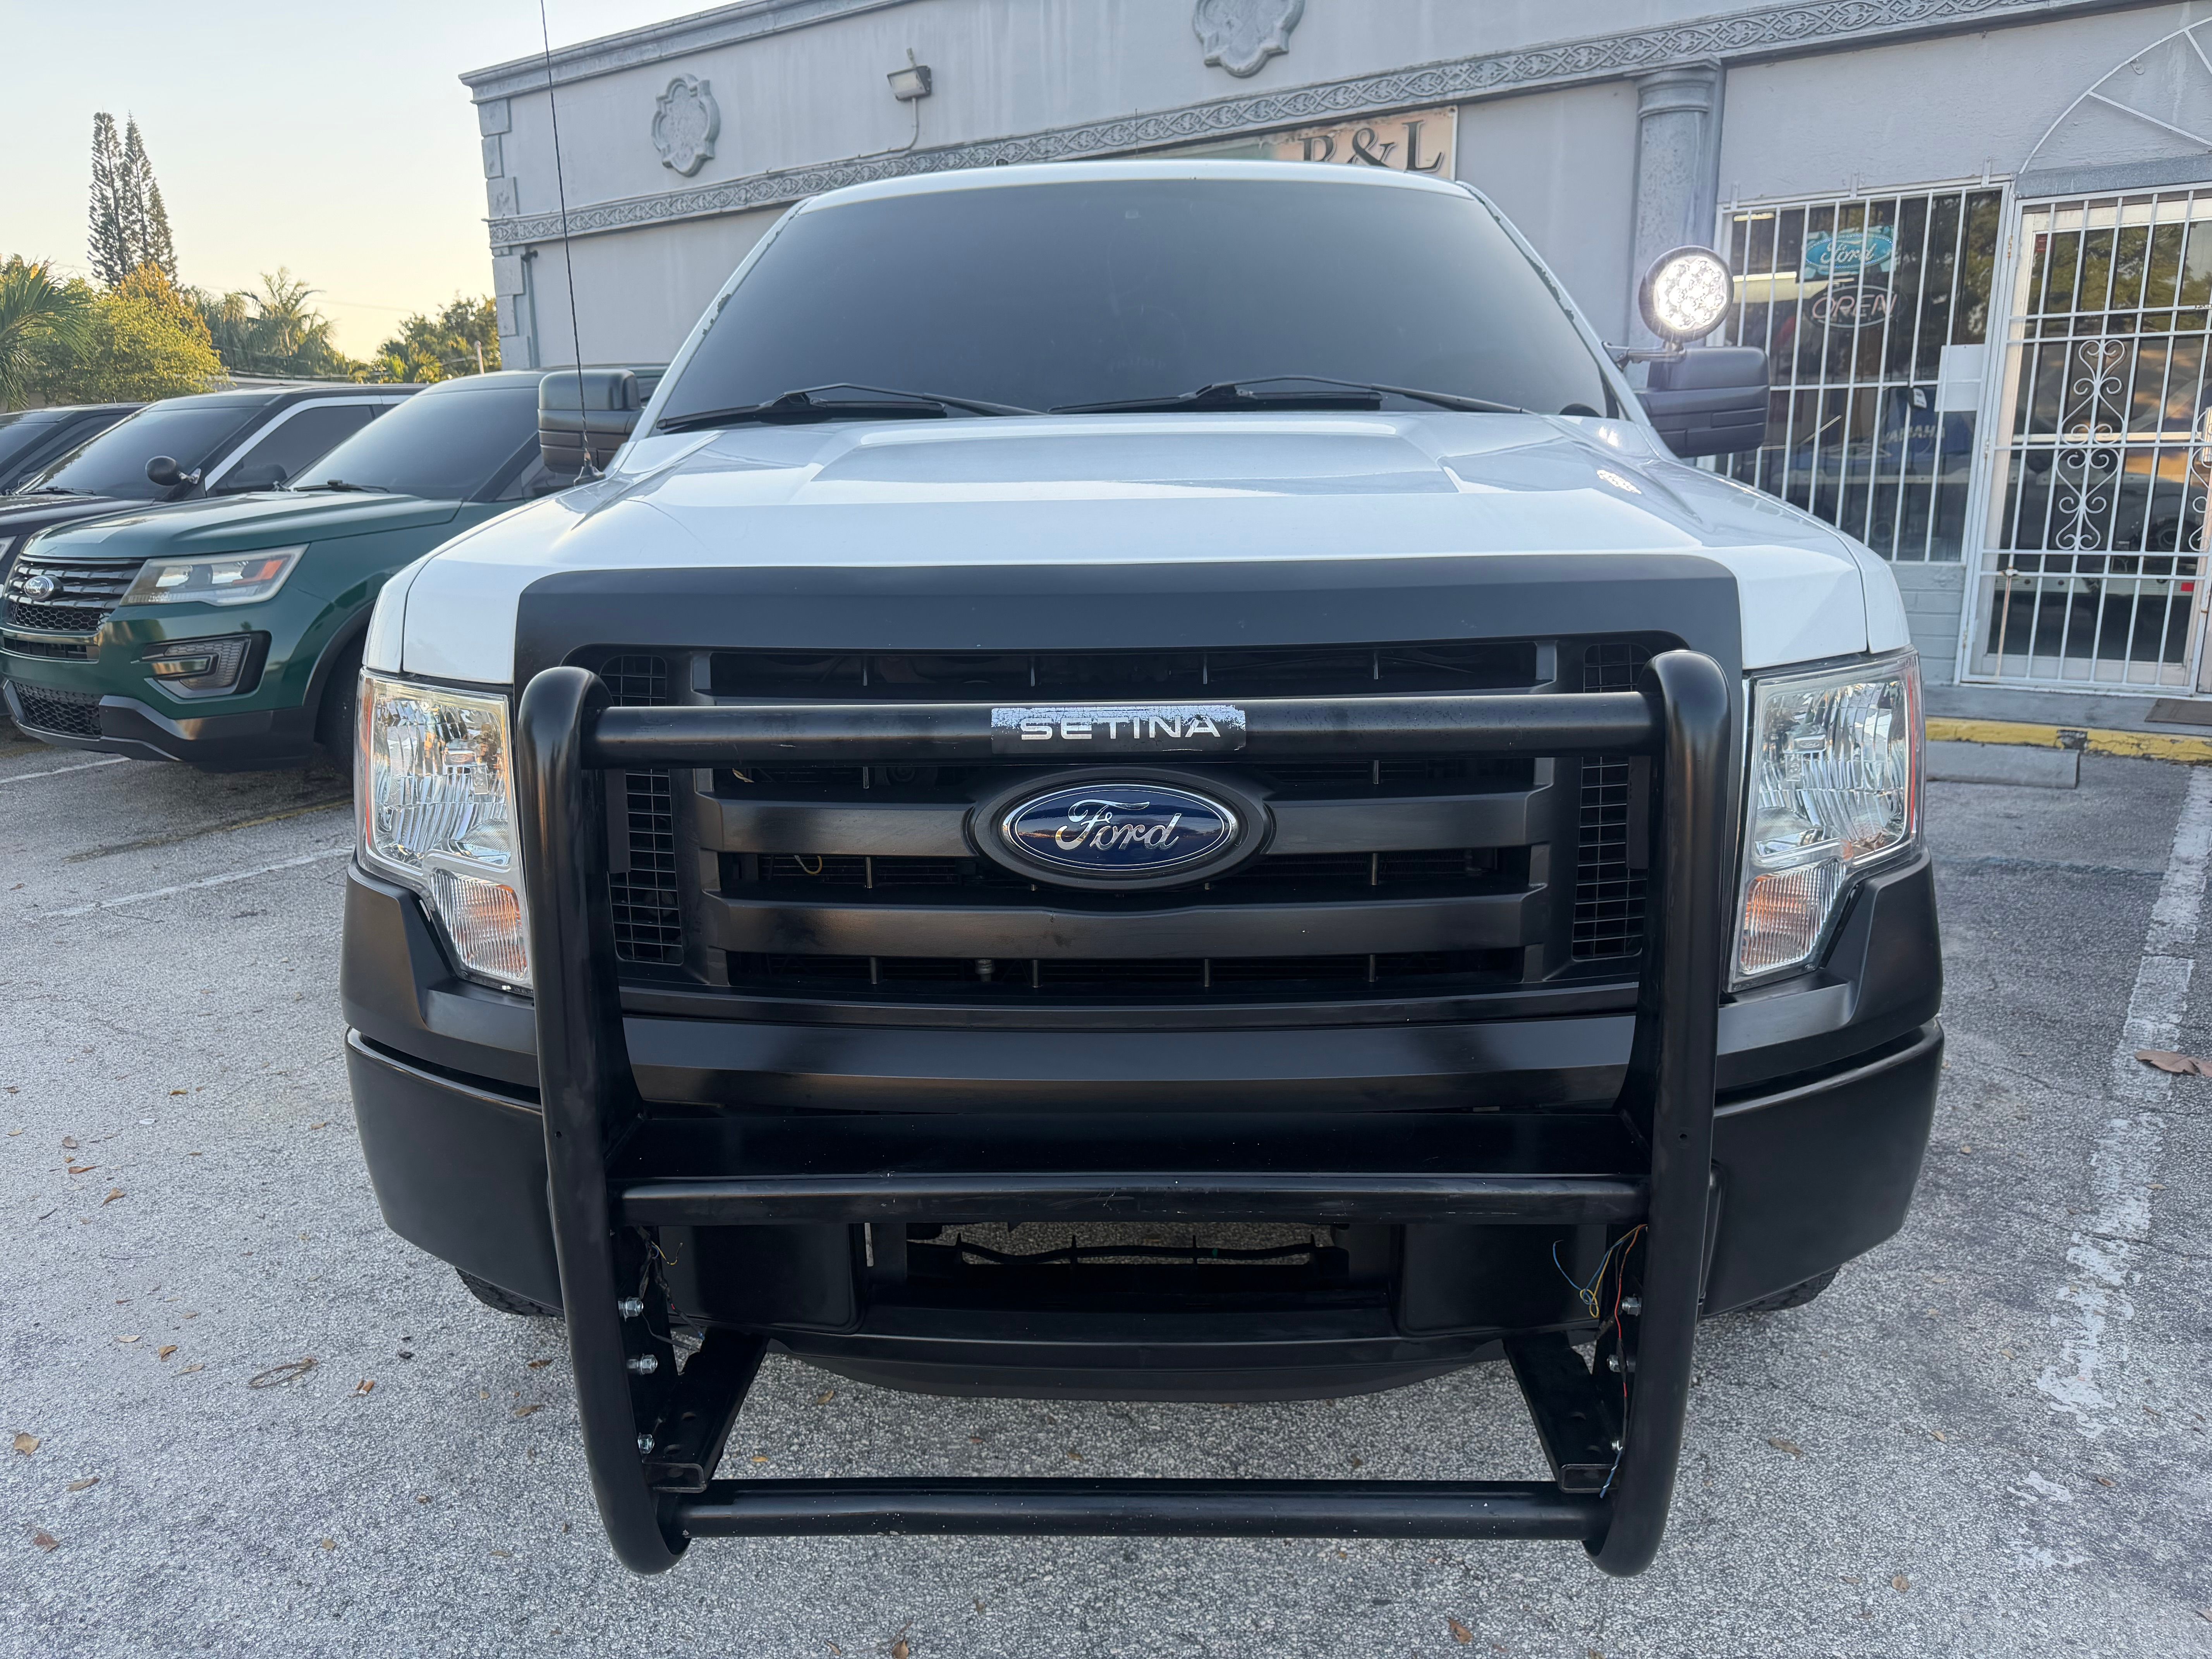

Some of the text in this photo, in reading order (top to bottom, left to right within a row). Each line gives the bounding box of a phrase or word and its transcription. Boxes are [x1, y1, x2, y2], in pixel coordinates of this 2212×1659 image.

[1820, 239, 1877, 264] Ford
[1812, 294, 1897, 321] OPEN
[1020, 715, 1221, 740] SETINA
[1055, 799, 1182, 850] Ford
